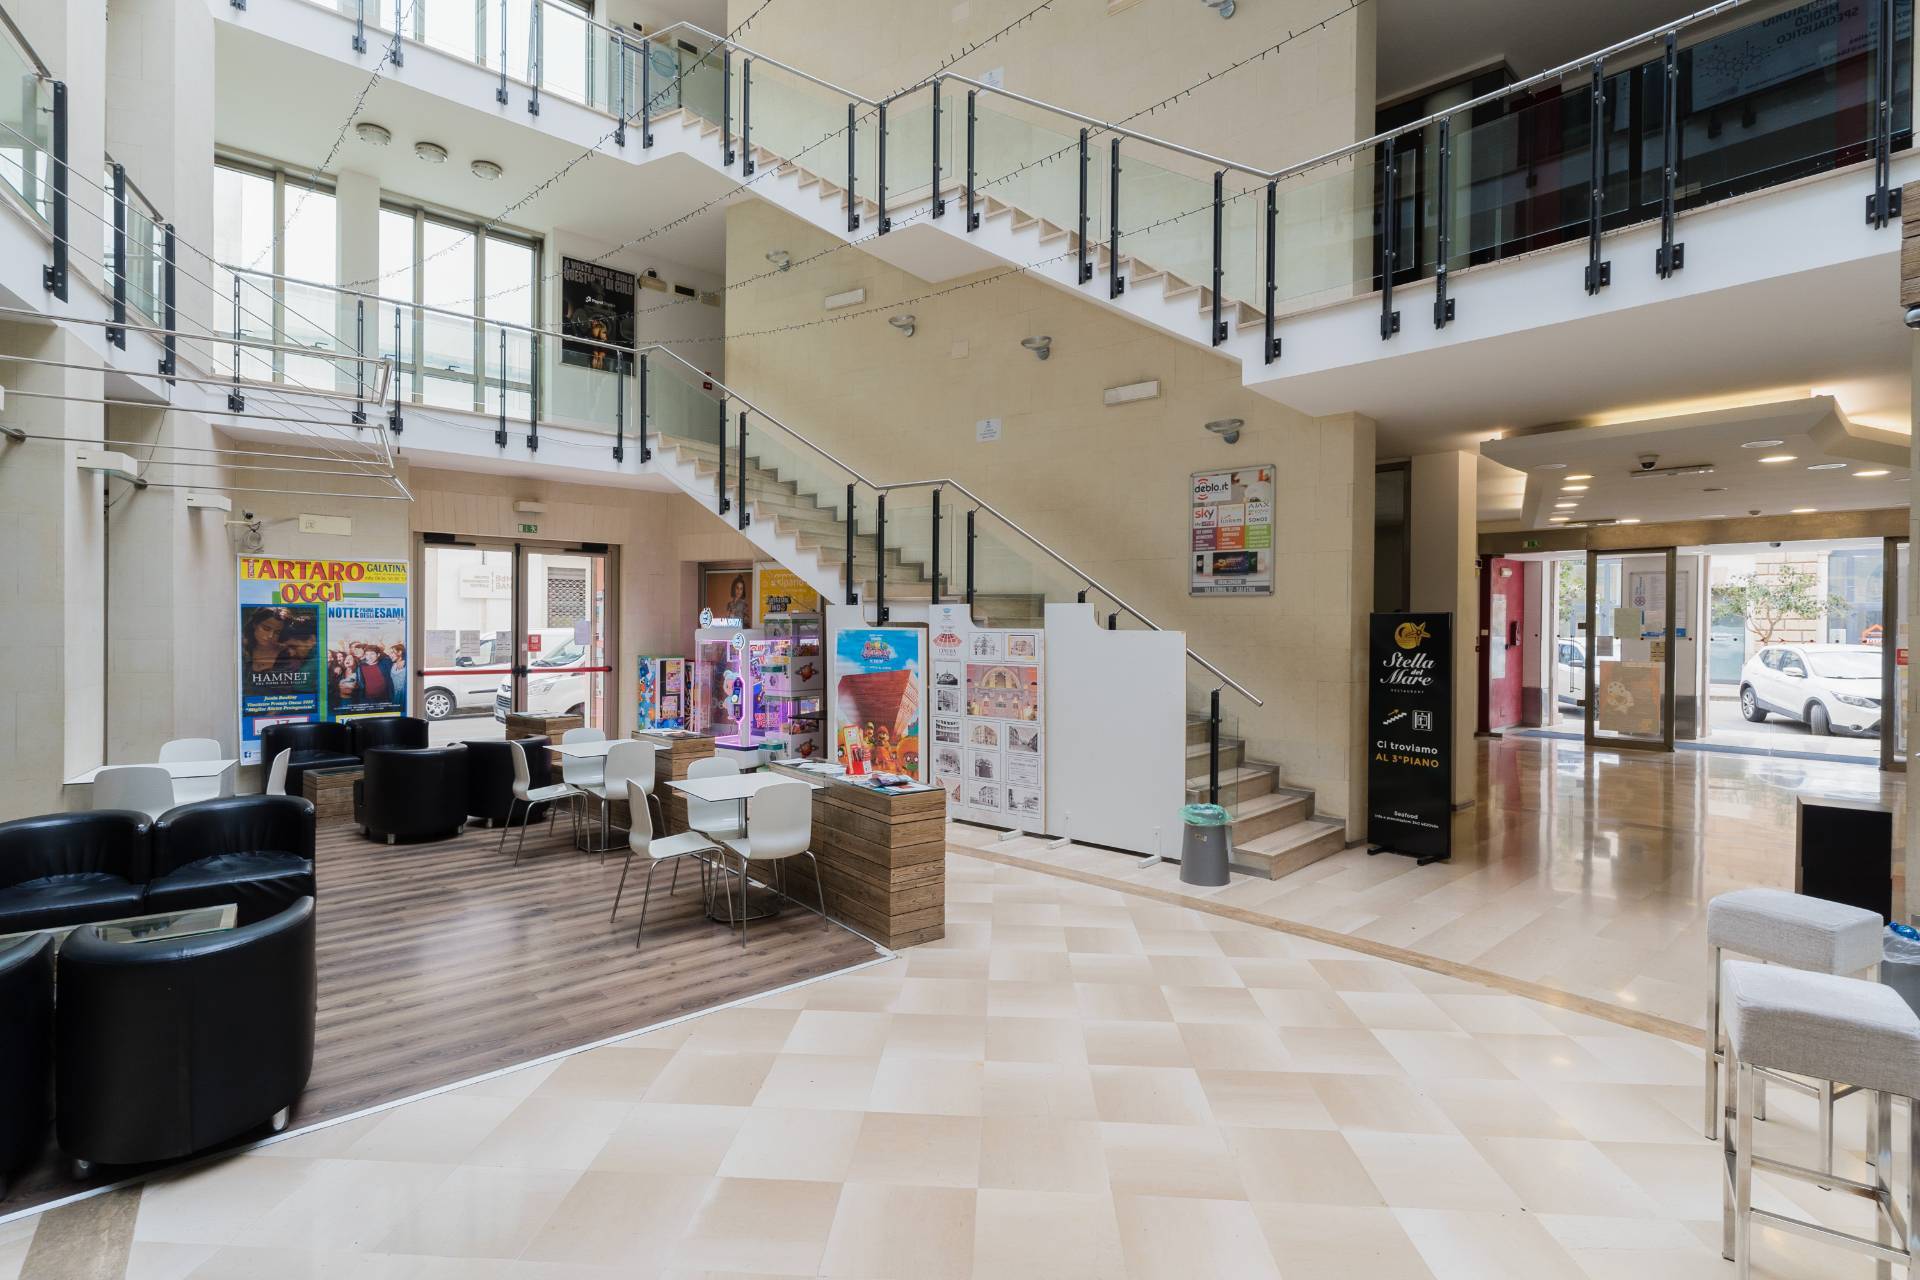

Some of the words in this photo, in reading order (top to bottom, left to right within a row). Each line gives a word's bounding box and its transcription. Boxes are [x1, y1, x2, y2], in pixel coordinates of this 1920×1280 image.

[1194, 482, 1229, 493] deblo.it
[1194, 508, 1214, 520] sky
[242, 558, 365, 582] TARTARO
[366, 563, 406, 573] GALATINA
[281, 582, 342, 603] OGGI
[328, 607, 360, 619] NOTTE
[374, 607, 404, 619] ESAMI
[1382, 651, 1436, 669] Stella
[252, 672, 310, 682] HAMNET
[1379, 668, 1434, 686] Mare
[1376, 740, 1387, 749] Ci
[1390, 741, 1438, 755] troviamo
[1375, 752, 1389, 762] AL
[1394, 810, 1419, 820] Seafood
